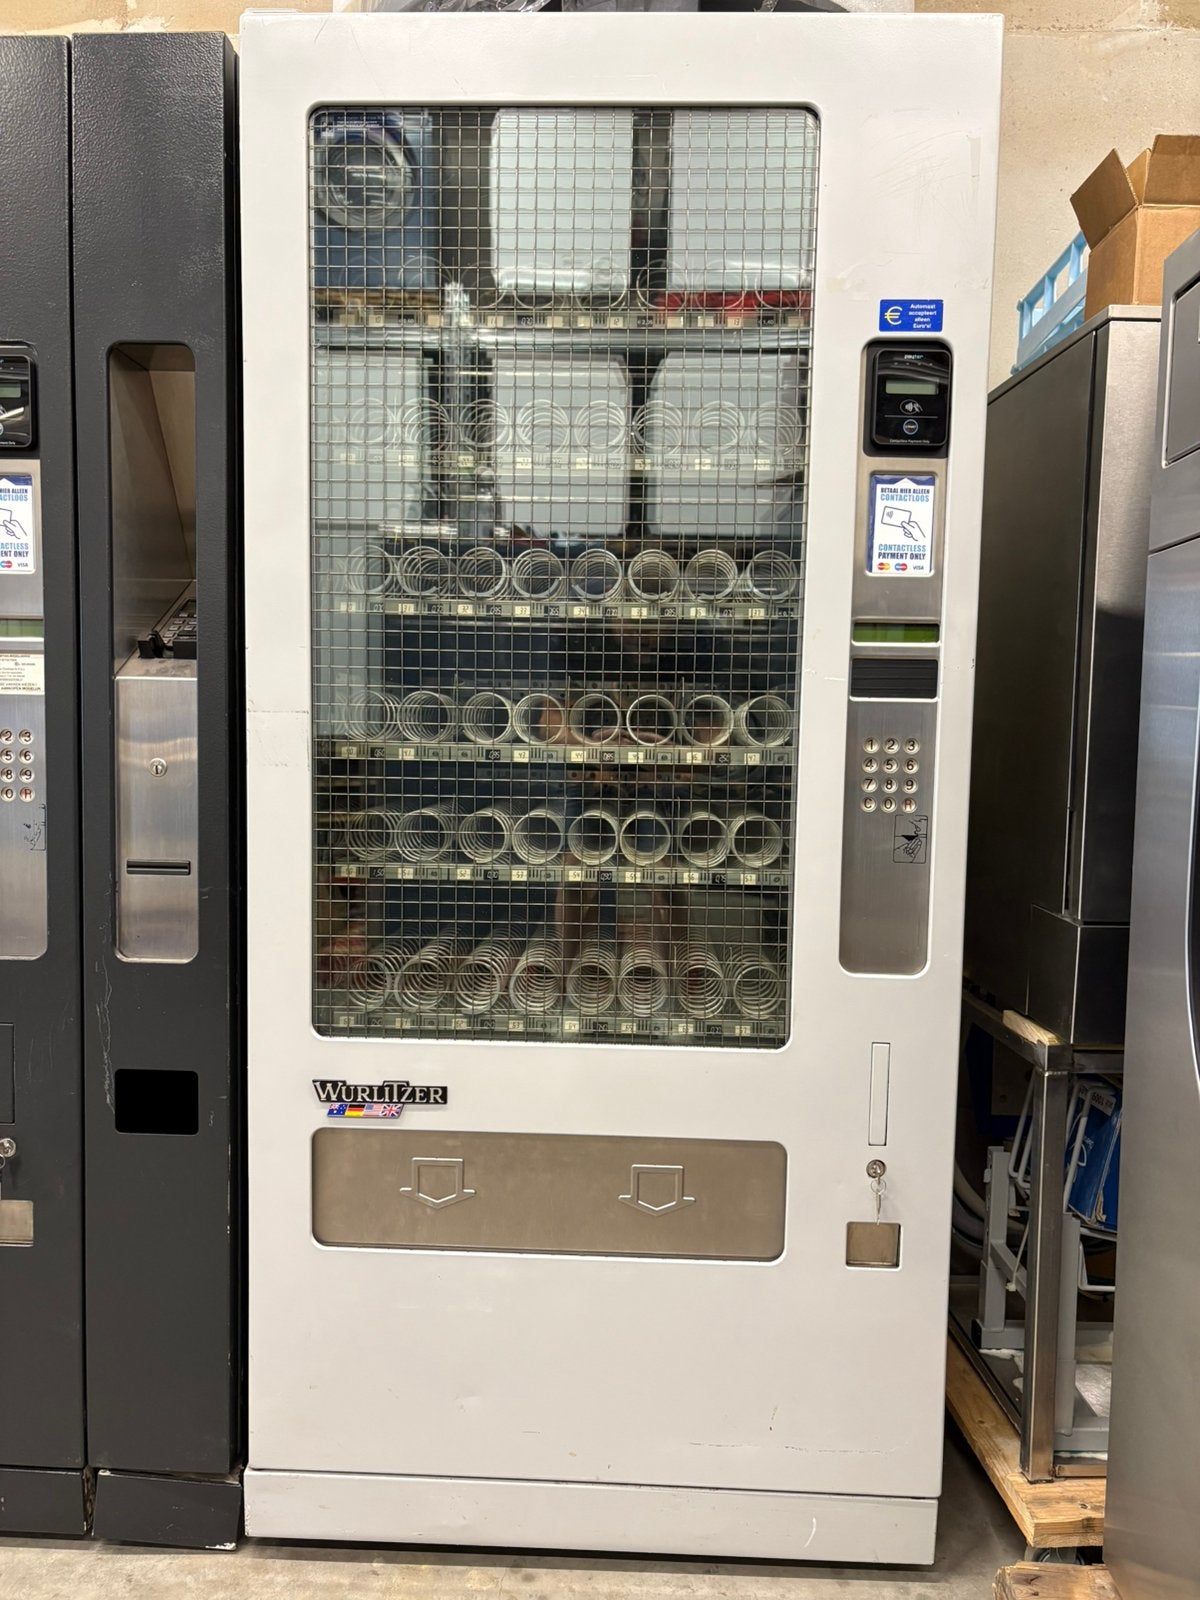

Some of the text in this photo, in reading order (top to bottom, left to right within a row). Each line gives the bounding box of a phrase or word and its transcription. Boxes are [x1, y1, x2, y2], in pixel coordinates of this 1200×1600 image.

[880, 494, 929, 502] CONTACTLOOS
[878, 544, 926, 552] CONTACTLESS
[5, 731, 31, 742] 2 3
[868, 740, 915, 751] 1 2 3
[5, 750, 31, 760] 5 6
[865, 759, 914, 770] 4 5 6
[5, 770, 32, 780] 8 9
[865, 779, 914, 790] 7 8 9
[25, 789, 31, 799] R
[864, 798, 872, 809] C
[313, 1081, 445, 1103] WURLITZER
